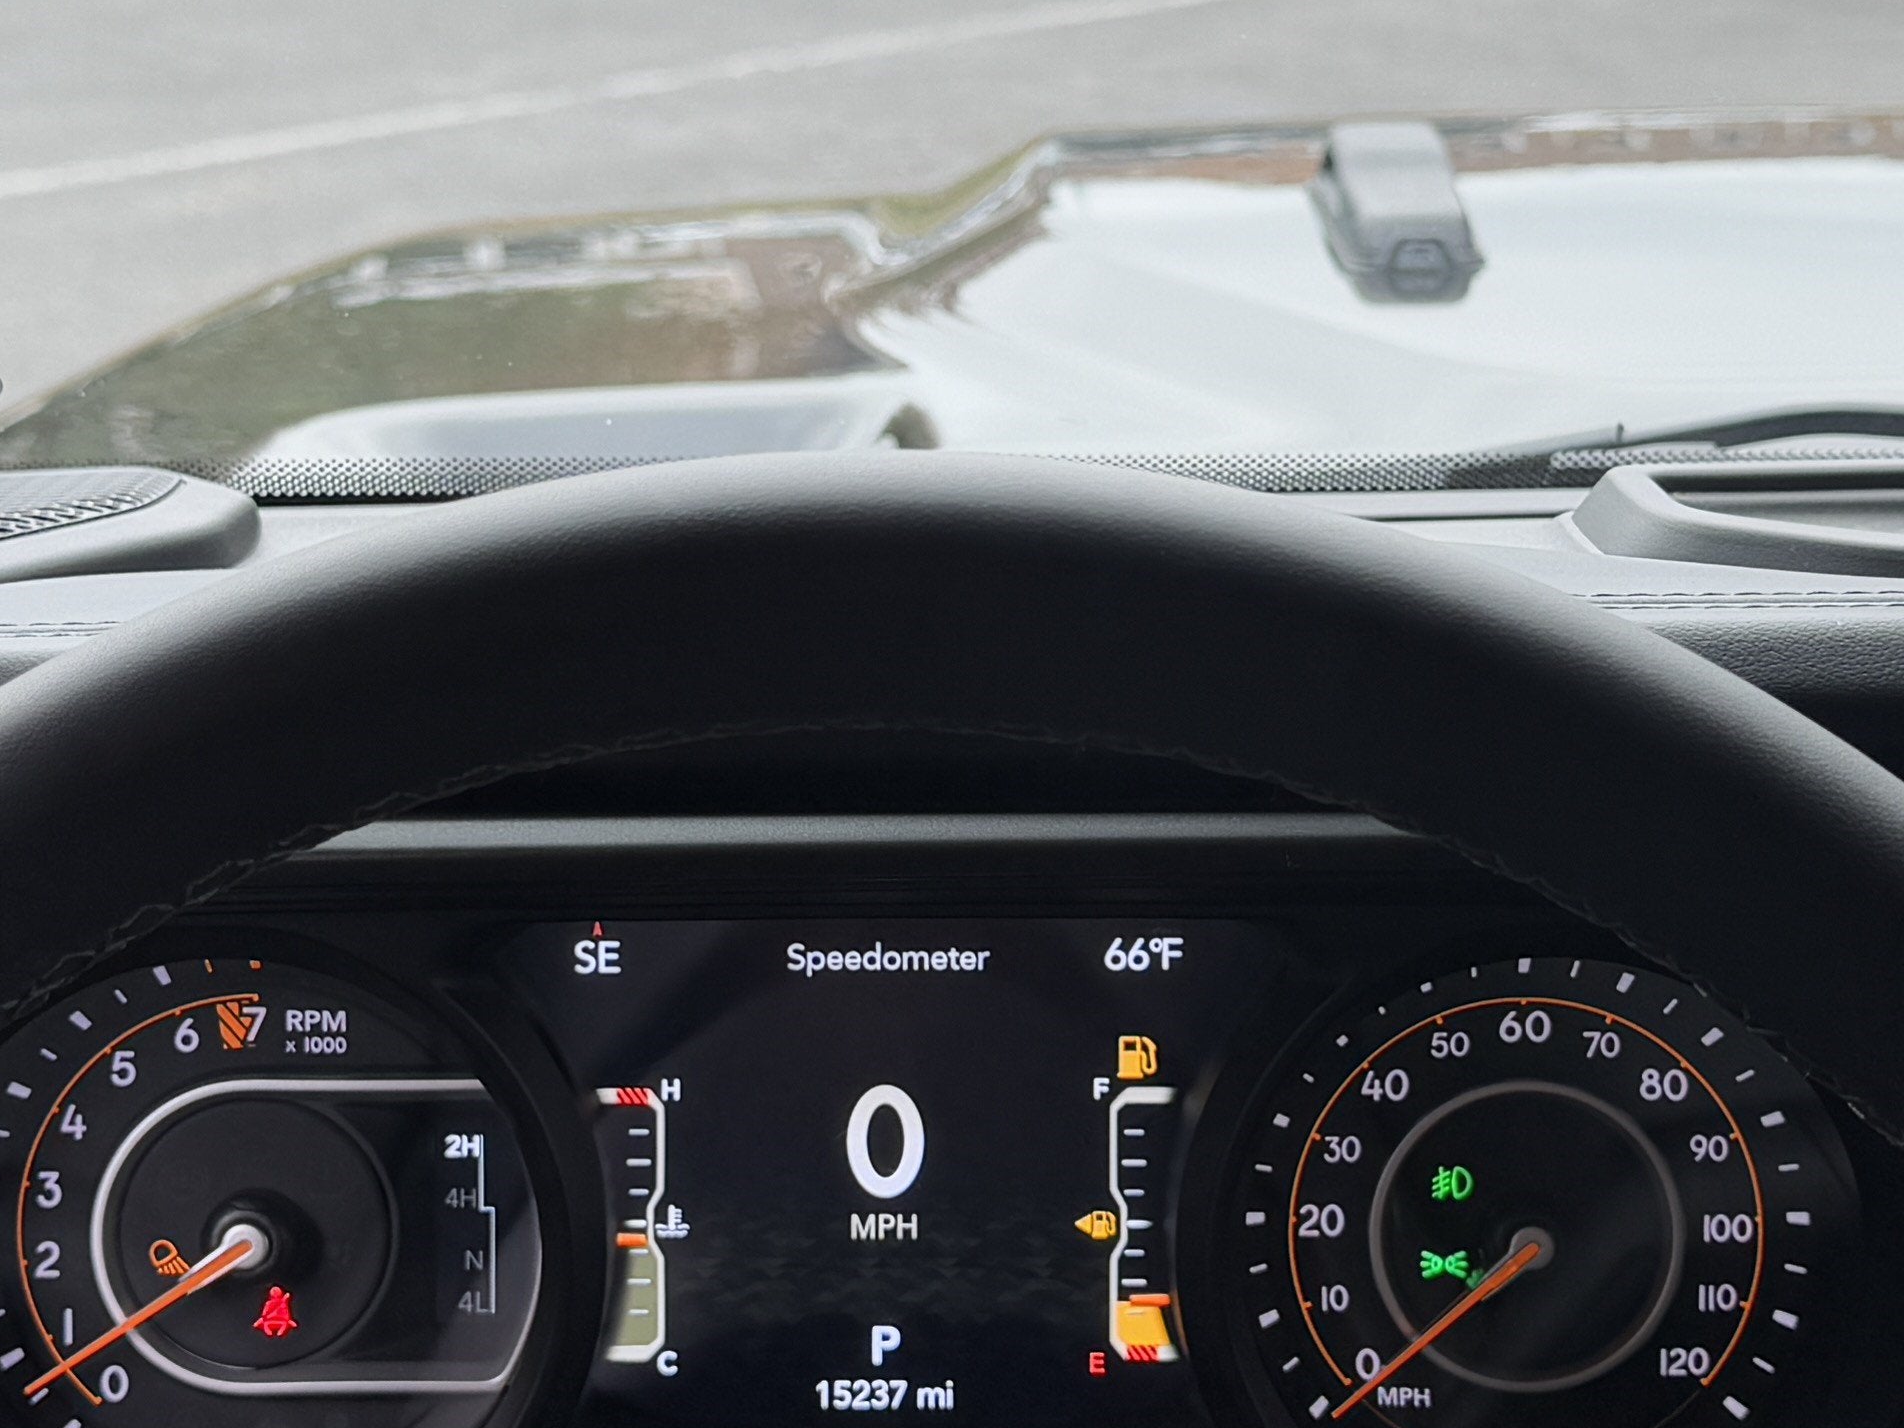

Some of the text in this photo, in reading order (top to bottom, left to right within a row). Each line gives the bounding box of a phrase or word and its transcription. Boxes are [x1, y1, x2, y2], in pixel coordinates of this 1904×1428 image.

[574, 941, 621, 975] SE
[786, 943, 990, 977] Speedometer
[1103, 937, 1183, 972] 66°F
[174, 1018, 200, 1053] 6
[243, 1005, 268, 1043] 7
[285, 1010, 348, 1032] RPM
[1498, 1010, 1551, 1043] 60
[303, 1036, 348, 1054] 1000
[1430, 1031, 1470, 1058] 50
[1582, 1031, 1621, 1059] 70
[109, 1051, 136, 1087] 5
[661, 1079, 681, 1102] H
[1094, 1078, 1110, 1099] F
[1360, 1069, 1409, 1103] 40
[1639, 1069, 1688, 1103] 80
[60, 1105, 87, 1140] 4
[444, 1135, 480, 1159] 2H
[846, 1083, 925, 1199] 0
[1323, 1135, 1361, 1163] 30
[1689, 1134, 1728, 1162] 90
[38, 1172, 63, 1208] 3
[444, 1187, 478, 1209] 4H
[850, 1214, 919, 1241] MPH
[1298, 1204, 1345, 1238] 20
[1702, 1213, 1753, 1243] 100
[34, 1242, 60, 1278] 2
[464, 1251, 483, 1270] N
[1321, 1285, 1349, 1312] 10
[1698, 1284, 1735, 1312] 110
[63, 1308, 73, 1345] 1
[870, 1325, 901, 1366] P
[656, 1351, 679, 1377] C
[1089, 1352, 1106, 1375] E
[1355, 1348, 1381, 1382] 0
[1659, 1348, 1709, 1377] 120
[100, 1365, 129, 1402] 0
[815, 1380, 955, 1411] 15237 mi
[1377, 1387, 1431, 1408] MPH
